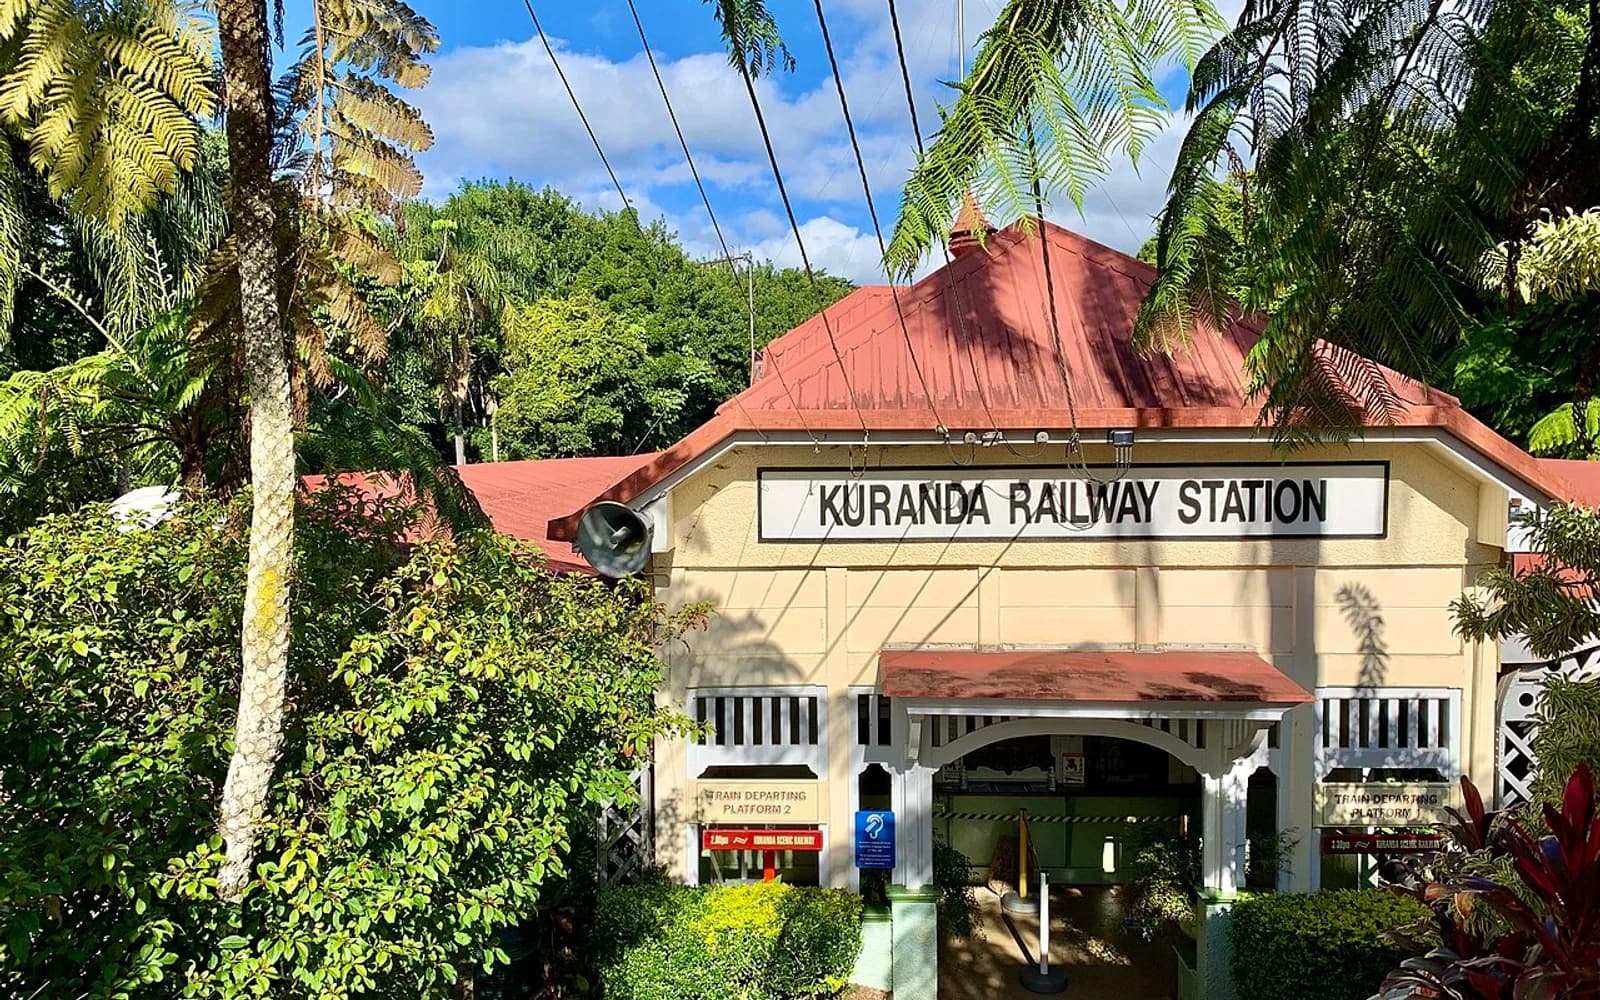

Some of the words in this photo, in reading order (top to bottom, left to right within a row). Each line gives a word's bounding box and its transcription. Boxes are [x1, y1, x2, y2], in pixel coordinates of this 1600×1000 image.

[819, 482, 991, 527] KURANDA
[1008, 481, 1160, 525] RAILWAY
[1177, 479, 1327, 525] STATION
[709, 791, 741, 801] TRAIN
[745, 791, 807, 801] DEPARTING
[1334, 794, 1369, 804] TRAIN
[1373, 794, 1438, 804] DEPARTING
[723, 804, 781, 814] PLATFORM
[783, 804, 792, 814] 2
